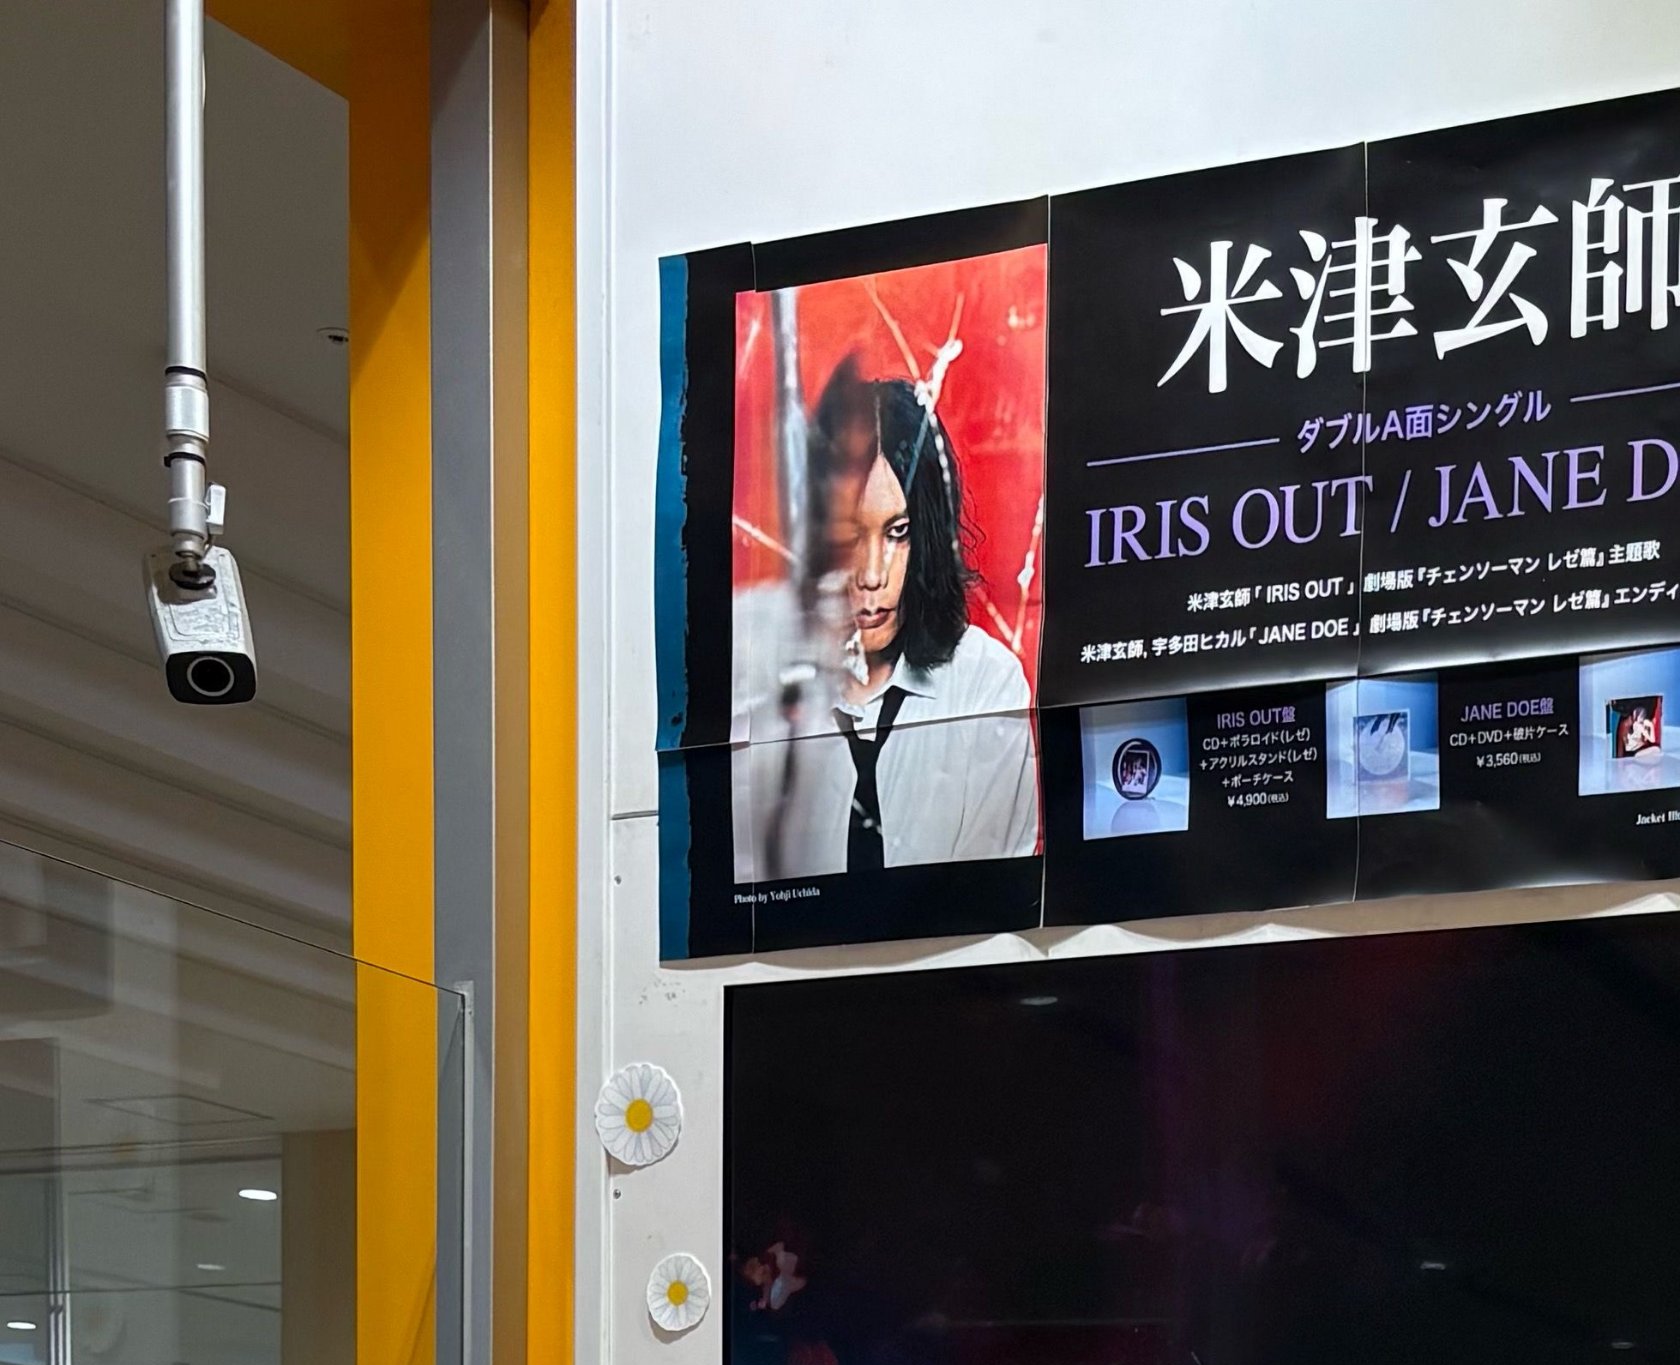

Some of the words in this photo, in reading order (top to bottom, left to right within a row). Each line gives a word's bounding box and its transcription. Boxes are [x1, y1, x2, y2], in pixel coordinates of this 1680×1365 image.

[1296, 390, 1552, 453] ダブルA面シングル
[1083, 496, 1211, 567] IRIS
[1231, 473, 1374, 550] OUT
[1427, 445, 1609, 528] JANE
[1217, 711, 1246, 729] IRIS
[1460, 702, 1503, 722] JANE
[1636, 812, 1667, 825] Jacket
